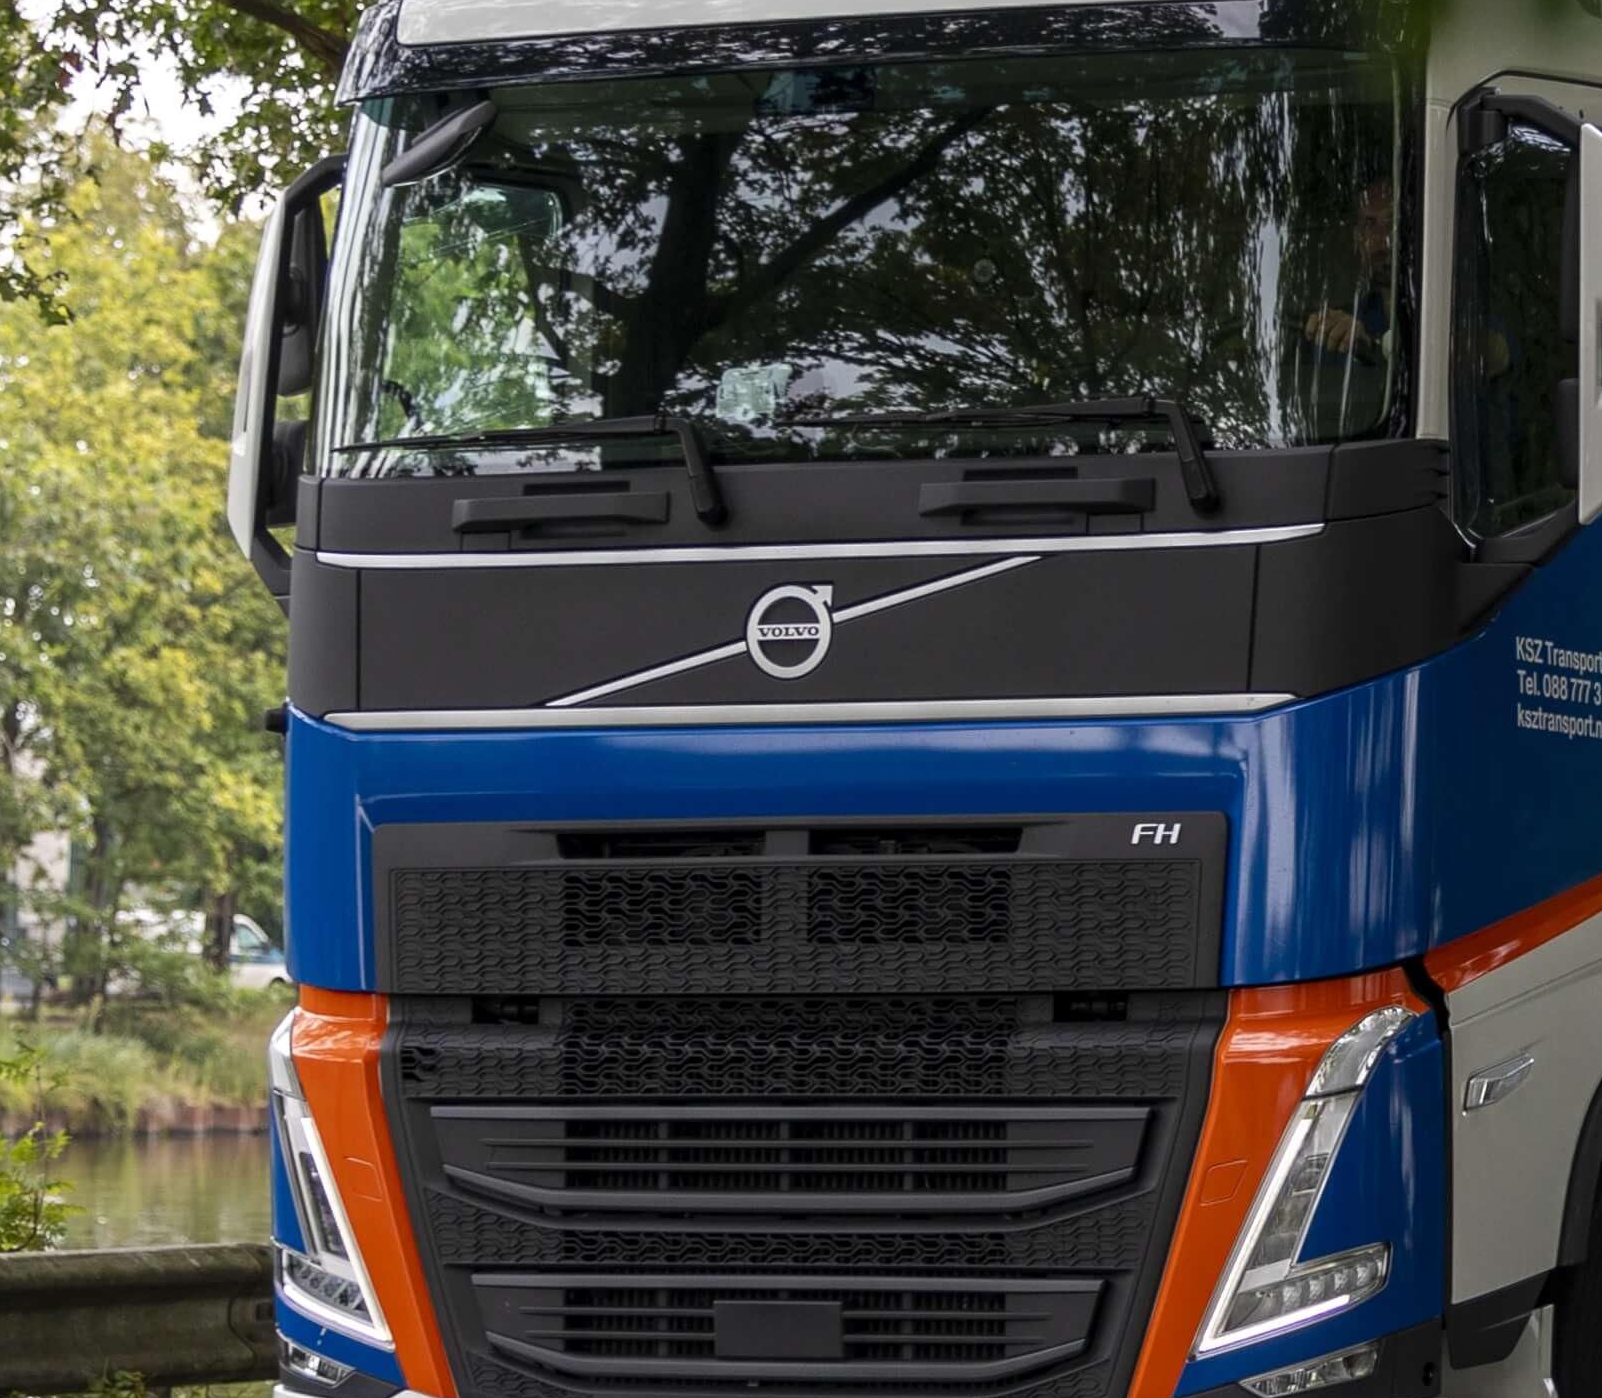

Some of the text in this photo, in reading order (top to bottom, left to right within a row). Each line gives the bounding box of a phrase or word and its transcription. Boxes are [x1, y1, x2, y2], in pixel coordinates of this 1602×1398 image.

[757, 625, 819, 637] VOLVO
[1515, 635, 1543, 663] KSZ
[1516, 668, 1540, 695] Tel.
[1542, 673, 1568, 700] 088
[1570, 677, 1591, 704] 777
[1593, 681, 1601, 706] 3
[1131, 823, 1181, 844] FH
